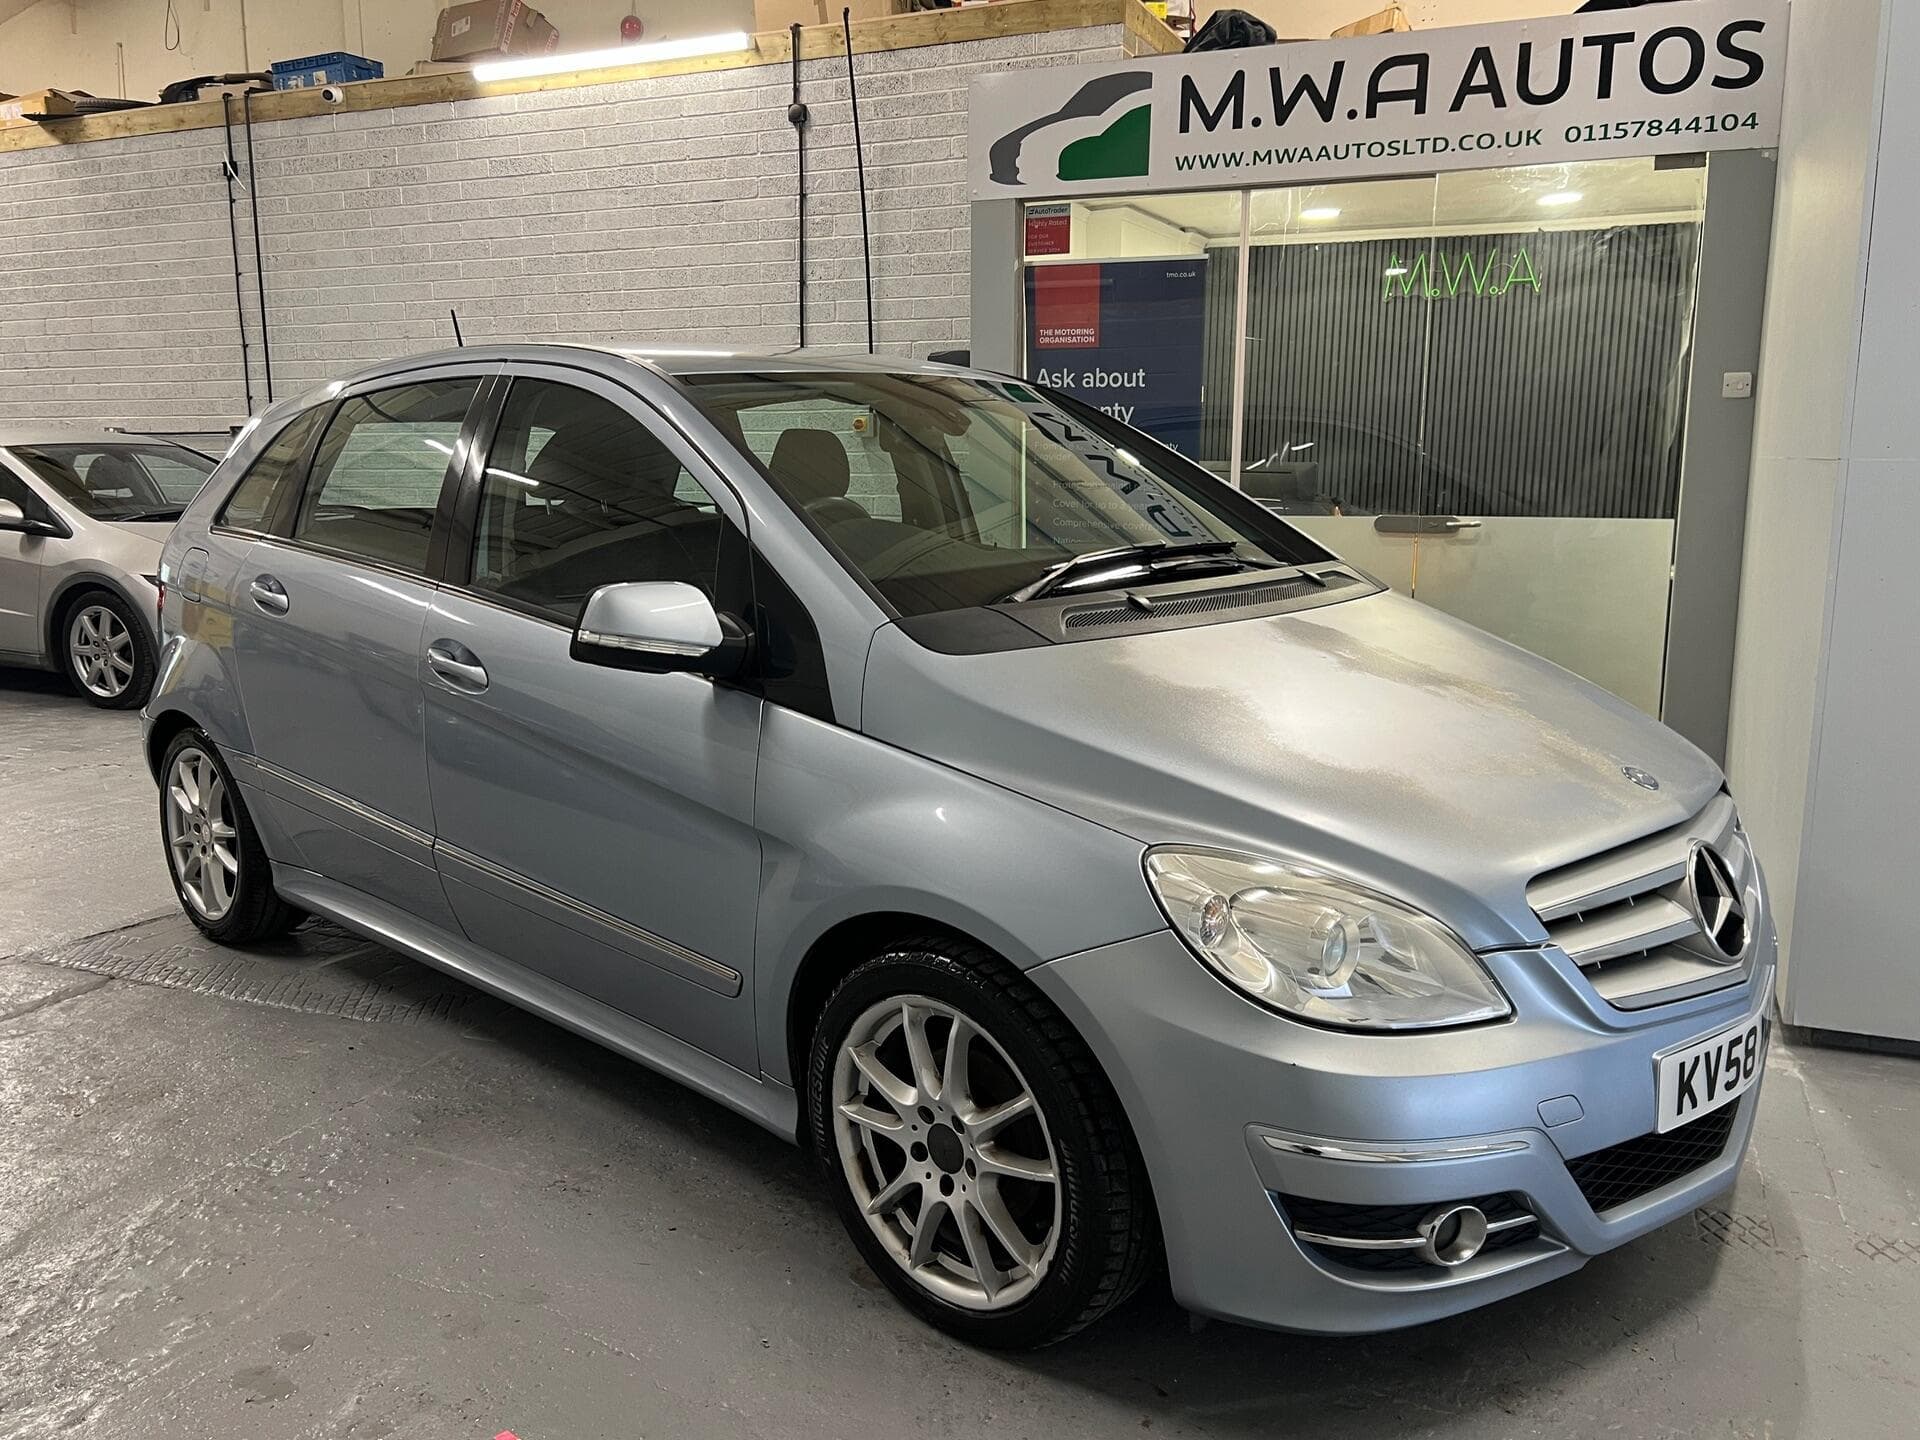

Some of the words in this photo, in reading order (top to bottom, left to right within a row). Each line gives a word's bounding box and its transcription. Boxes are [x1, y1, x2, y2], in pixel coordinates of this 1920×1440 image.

[1179, 53, 1430, 134] M.W.A
[1448, 20, 1766, 113] AUTOS
[1564, 111, 1760, 144] 01157844104
[1175, 128, 1543, 171] WWW.MWAAUTOSLTD.CO.UK
[1166, 270, 1196, 279] tmo.co.uk
[1384, 248, 1540, 303] M.W.A
[1039, 328, 1054, 337] THE
[1054, 327, 1095, 336] MOTORING
[1039, 335, 1095, 344] ORGANISATION
[1036, 367, 1076, 388] Ask
[1081, 367, 1146, 388] about
[1676, 1025, 1758, 1116] KV58
